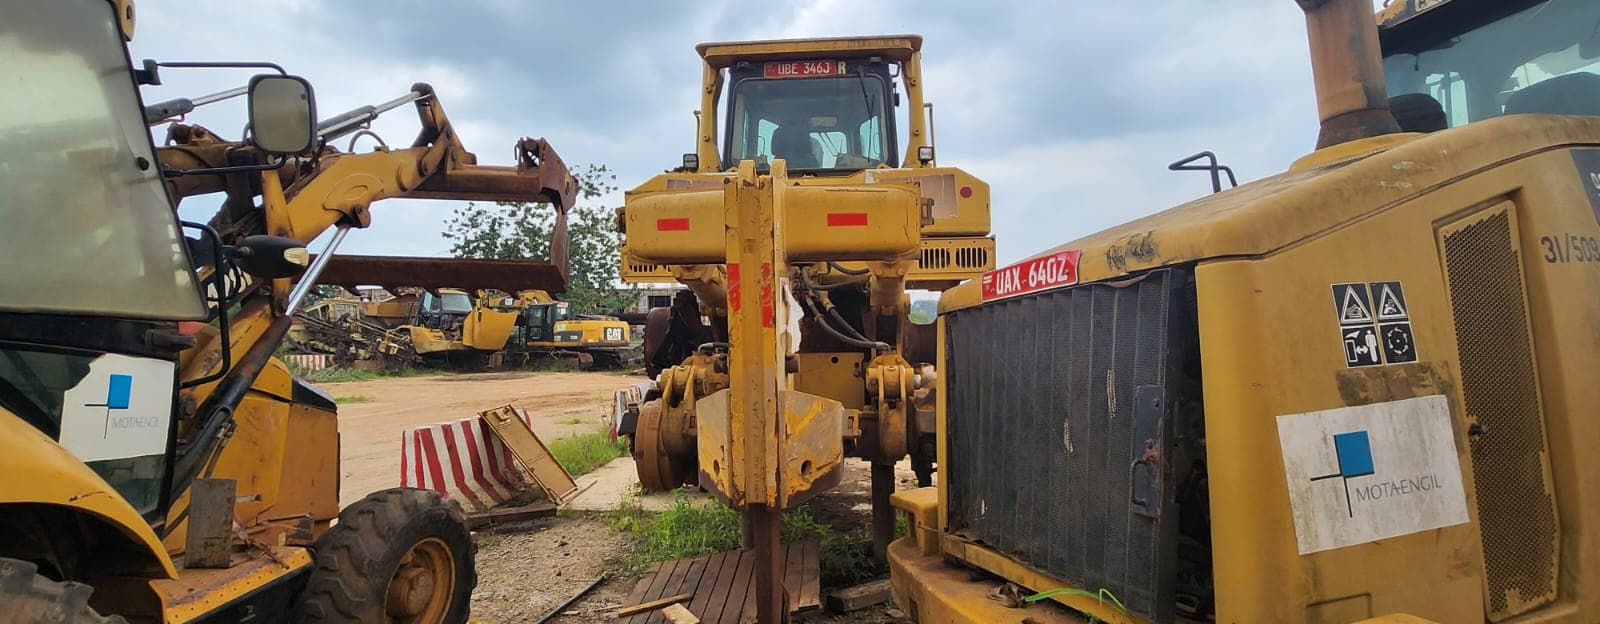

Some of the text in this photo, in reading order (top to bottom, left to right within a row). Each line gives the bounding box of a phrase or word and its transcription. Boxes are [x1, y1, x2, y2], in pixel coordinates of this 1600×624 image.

[778, 62, 830, 75] UBE 346J
[837, 61, 846, 75] R
[996, 255, 1068, 295] UAX 640Z
[606, 327, 622, 341] CAT
